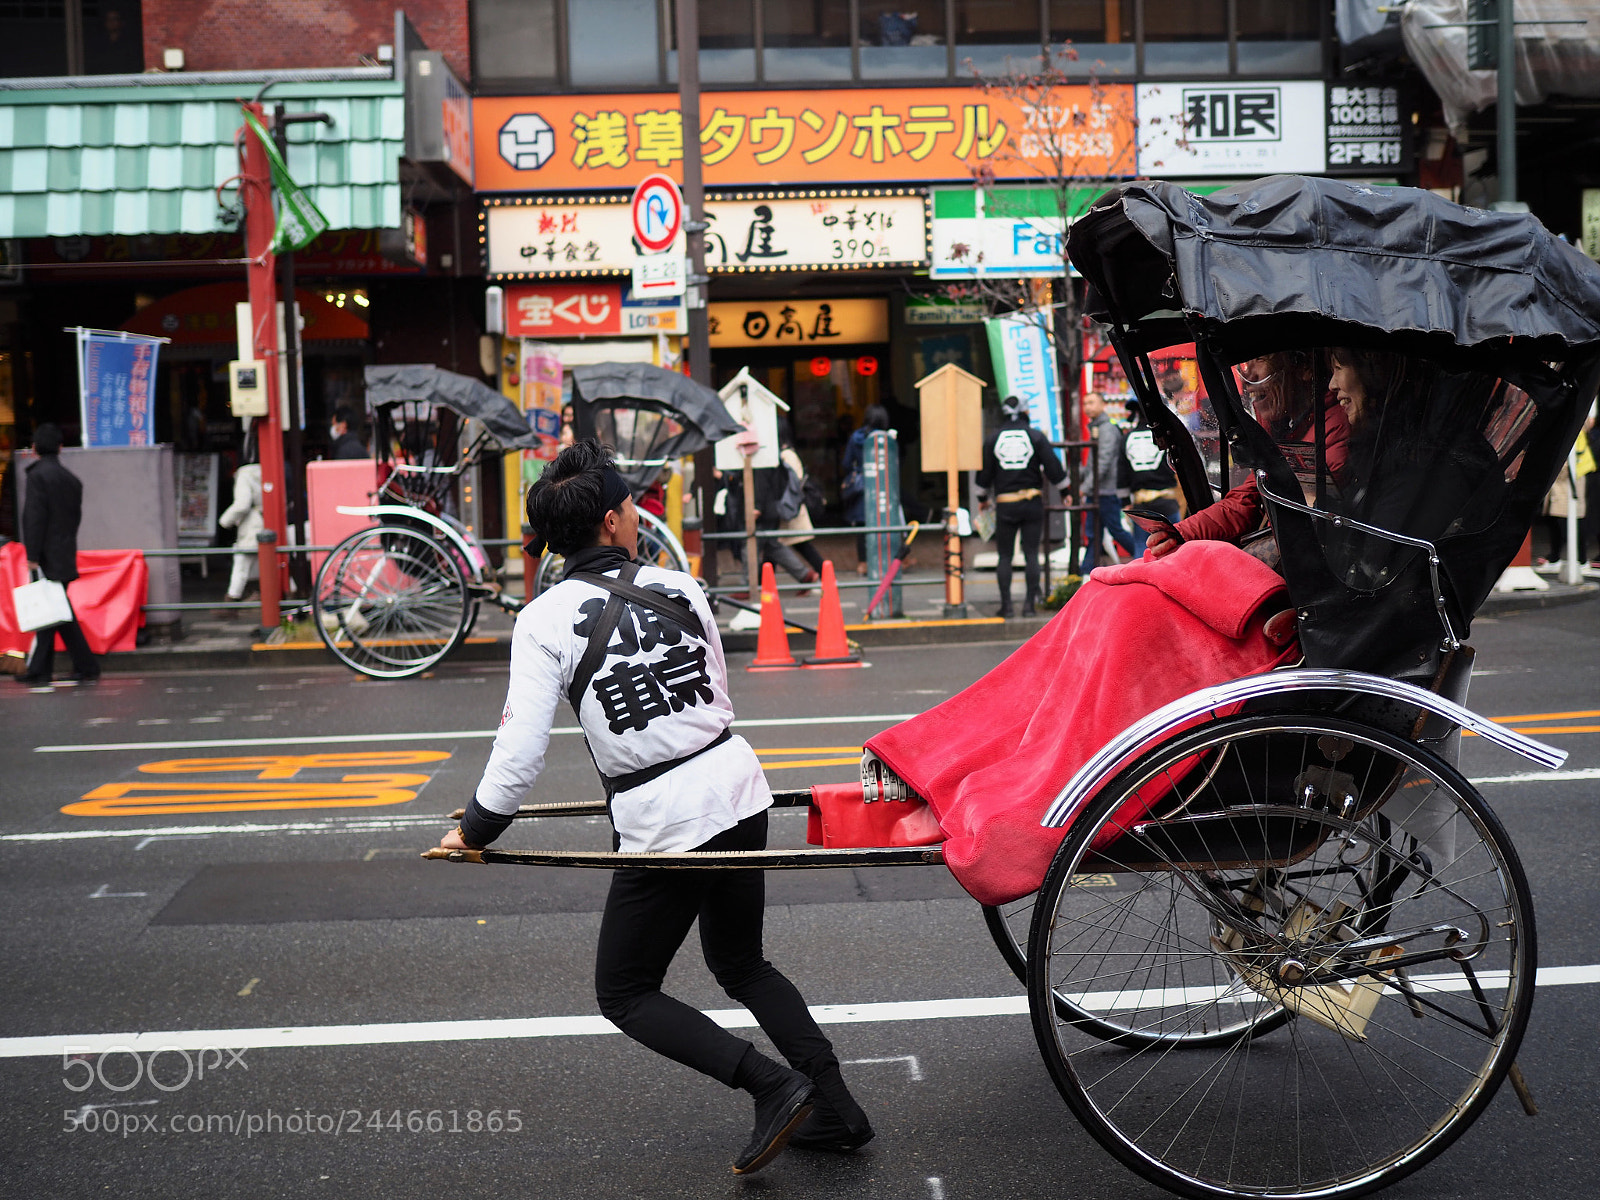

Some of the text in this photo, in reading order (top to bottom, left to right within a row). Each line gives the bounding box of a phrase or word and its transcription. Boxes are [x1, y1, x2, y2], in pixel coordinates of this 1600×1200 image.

[1187, 93, 1276, 138] 和民
[570, 105, 1008, 169] 浅草タウンホテル
[1329, 143, 1401, 164] 2F受付
[823, 205, 896, 234] 中華そば
[519, 239, 602, 265] 中華食堂
[516, 294, 611, 327] 宝くじ
[743, 304, 841, 341] 日高屋
